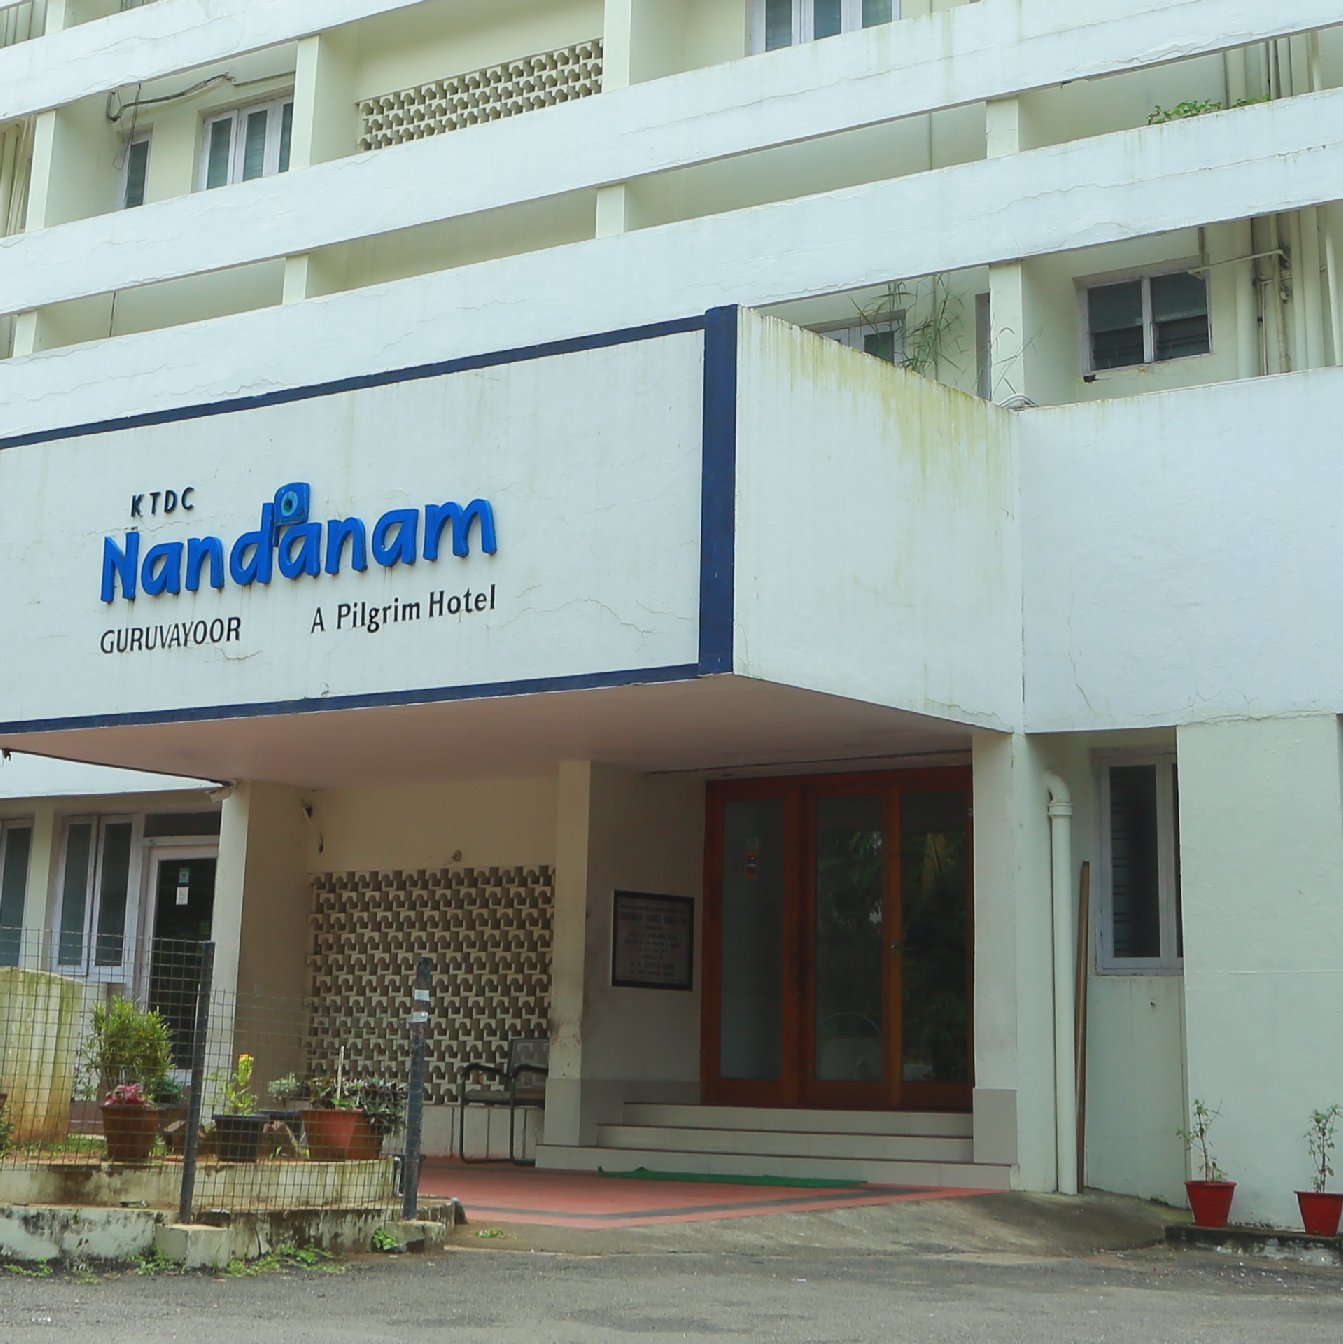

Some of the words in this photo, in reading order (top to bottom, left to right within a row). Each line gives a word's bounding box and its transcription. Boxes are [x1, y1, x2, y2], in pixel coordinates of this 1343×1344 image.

[130, 487, 195, 517] KTDC
[100, 494, 497, 602] Nandanam
[310, 606, 326, 633] A
[336, 597, 421, 633] Pilgrim
[428, 584, 495, 618] Hotel
[100, 616, 241, 654] GURUVAYOOR
